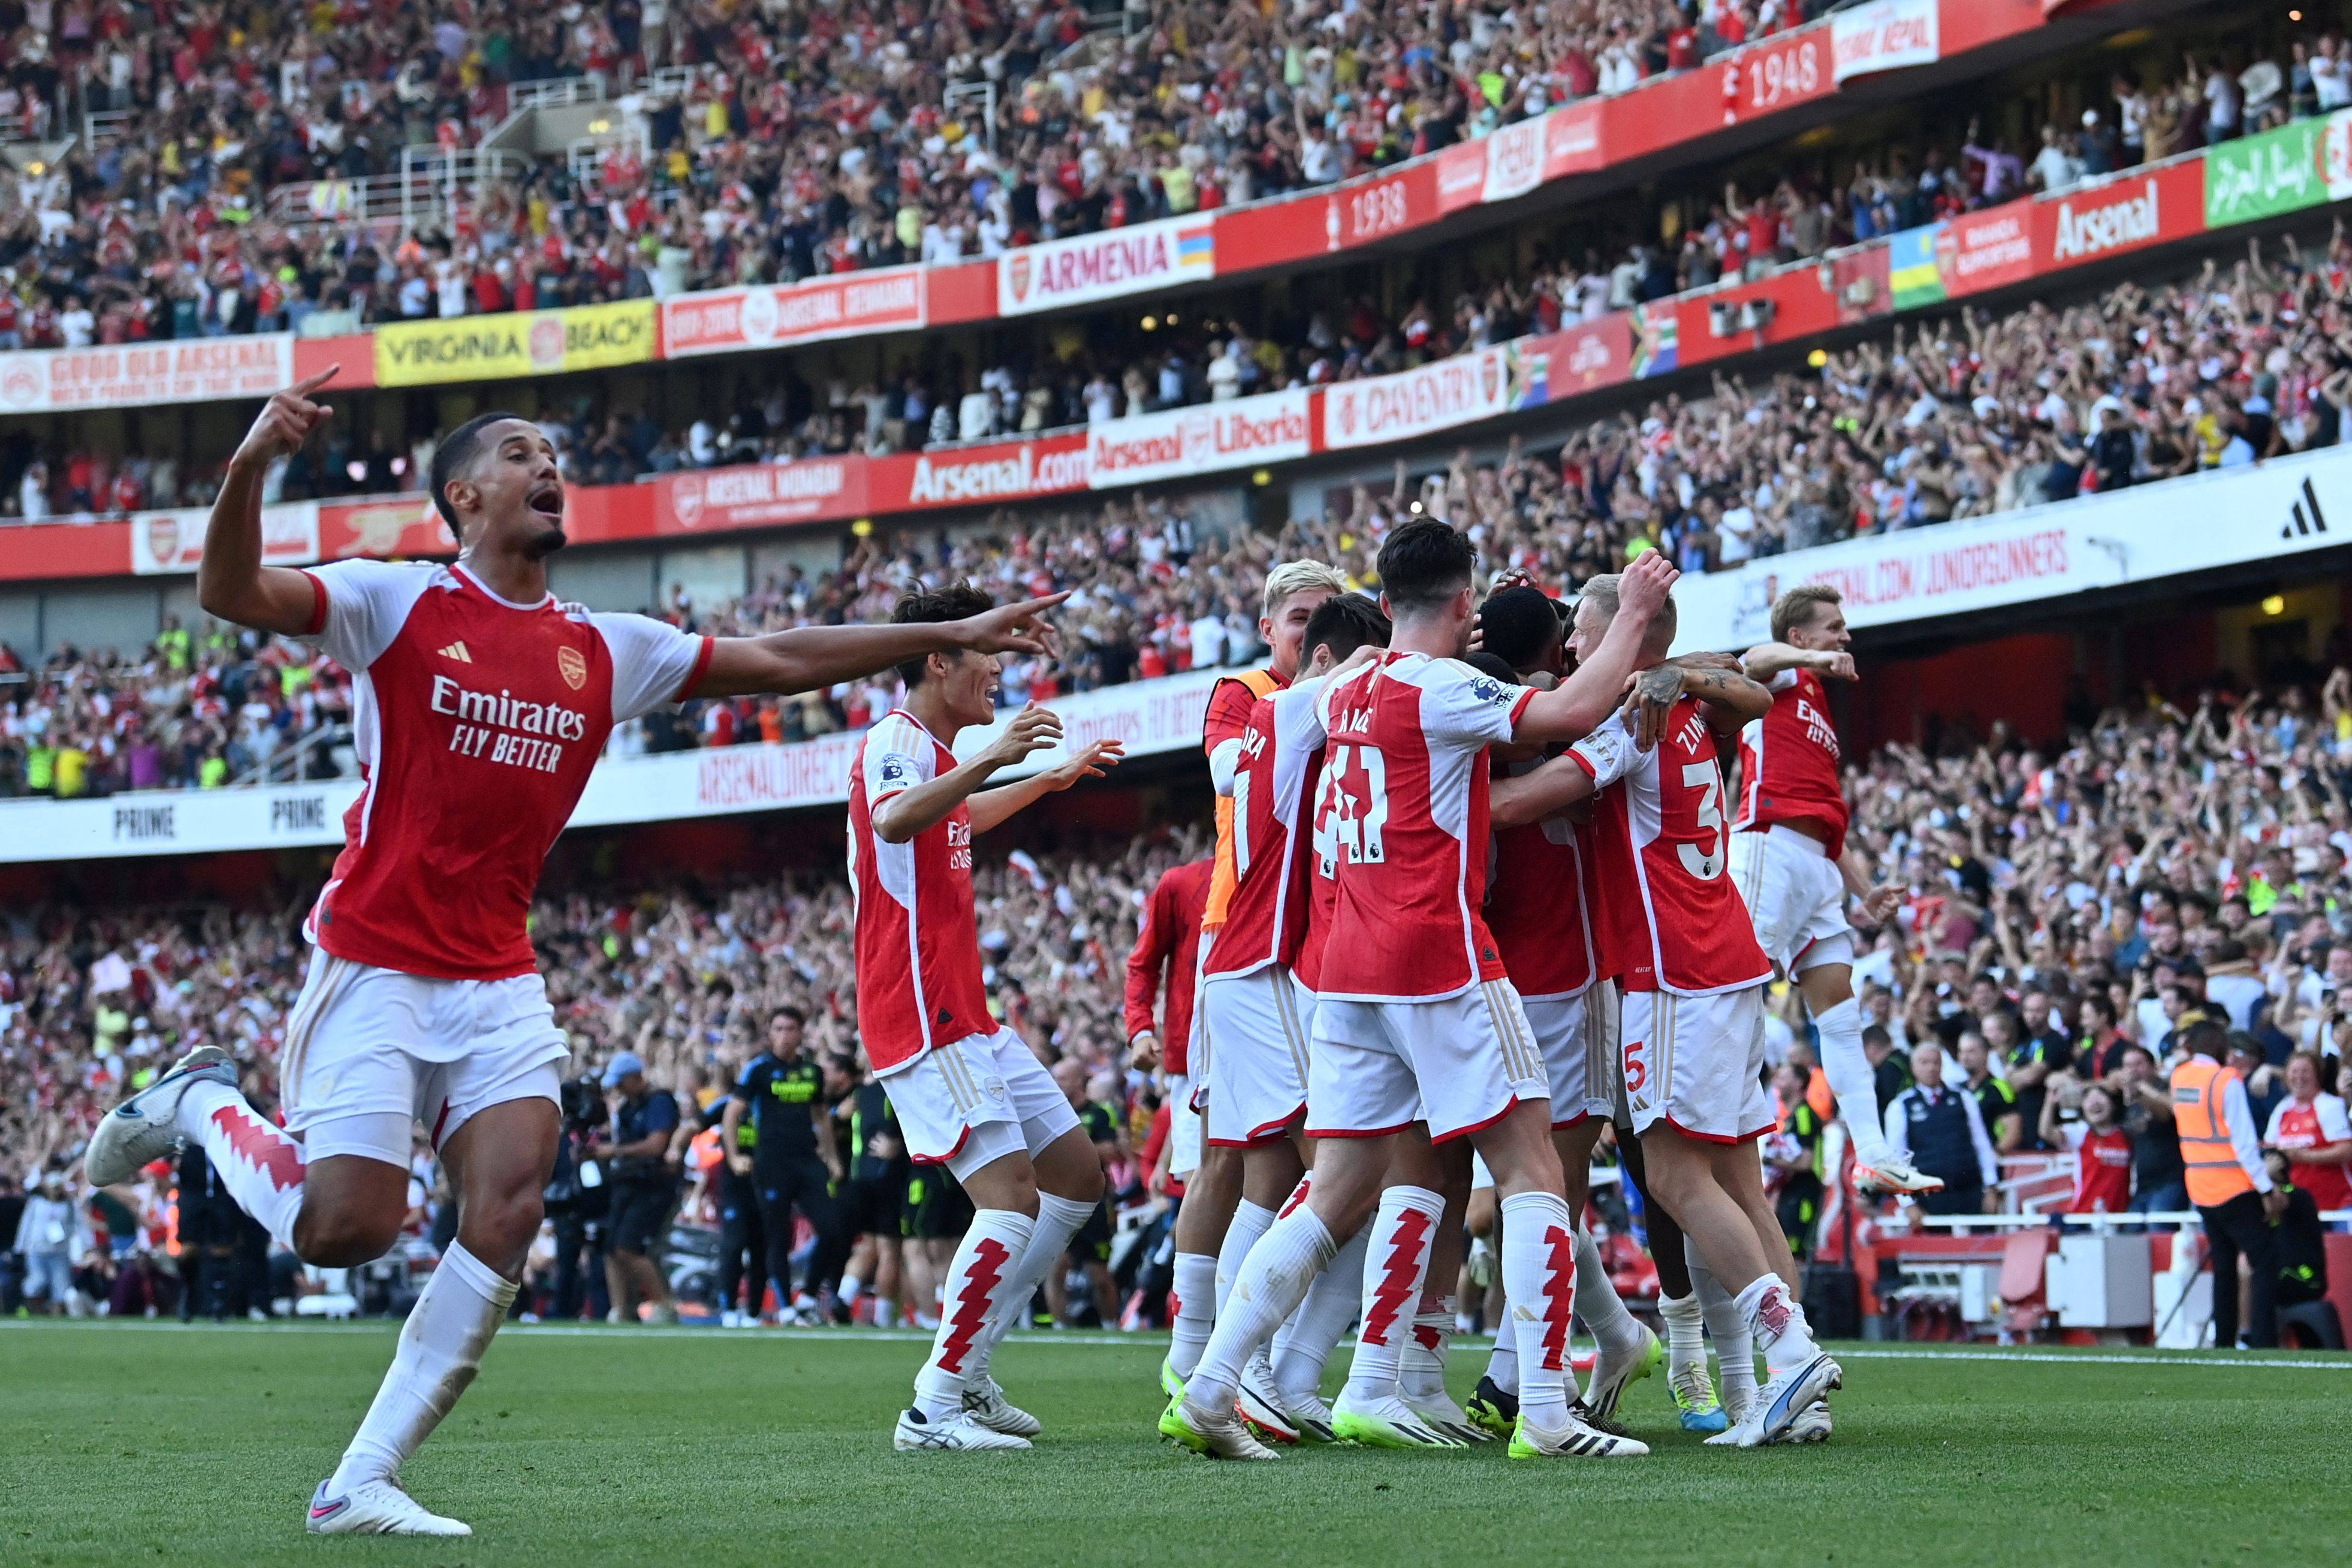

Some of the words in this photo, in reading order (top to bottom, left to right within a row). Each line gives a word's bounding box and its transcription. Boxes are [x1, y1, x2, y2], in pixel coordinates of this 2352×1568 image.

[1749, 42, 1819, 107] 1948
[1352, 180, 1408, 237] 1938
[2052, 178, 2159, 261] Arsenal
[1039, 232, 1169, 294] ARMENIA
[387, 333, 520, 364] VIRGINIA
[566, 316, 644, 351] BEACH
[1367, 366, 1475, 432] DAVENTRY
[1092, 422, 1183, 472] Arsenal
[1214, 405, 1308, 454] Liberia
[909, 445, 1089, 505] Arsenal.com
[430, 674, 586, 742] Emirates
[449, 724, 490, 758] FLY
[491, 735, 562, 773] BETTER
[1242, 725, 1267, 761] IRA
[114, 804, 176, 839] PRIME
[273, 796, 325, 831] PRIME
[1676, 756, 1727, 881] 3
[1624, 1041, 1645, 1092] 5
